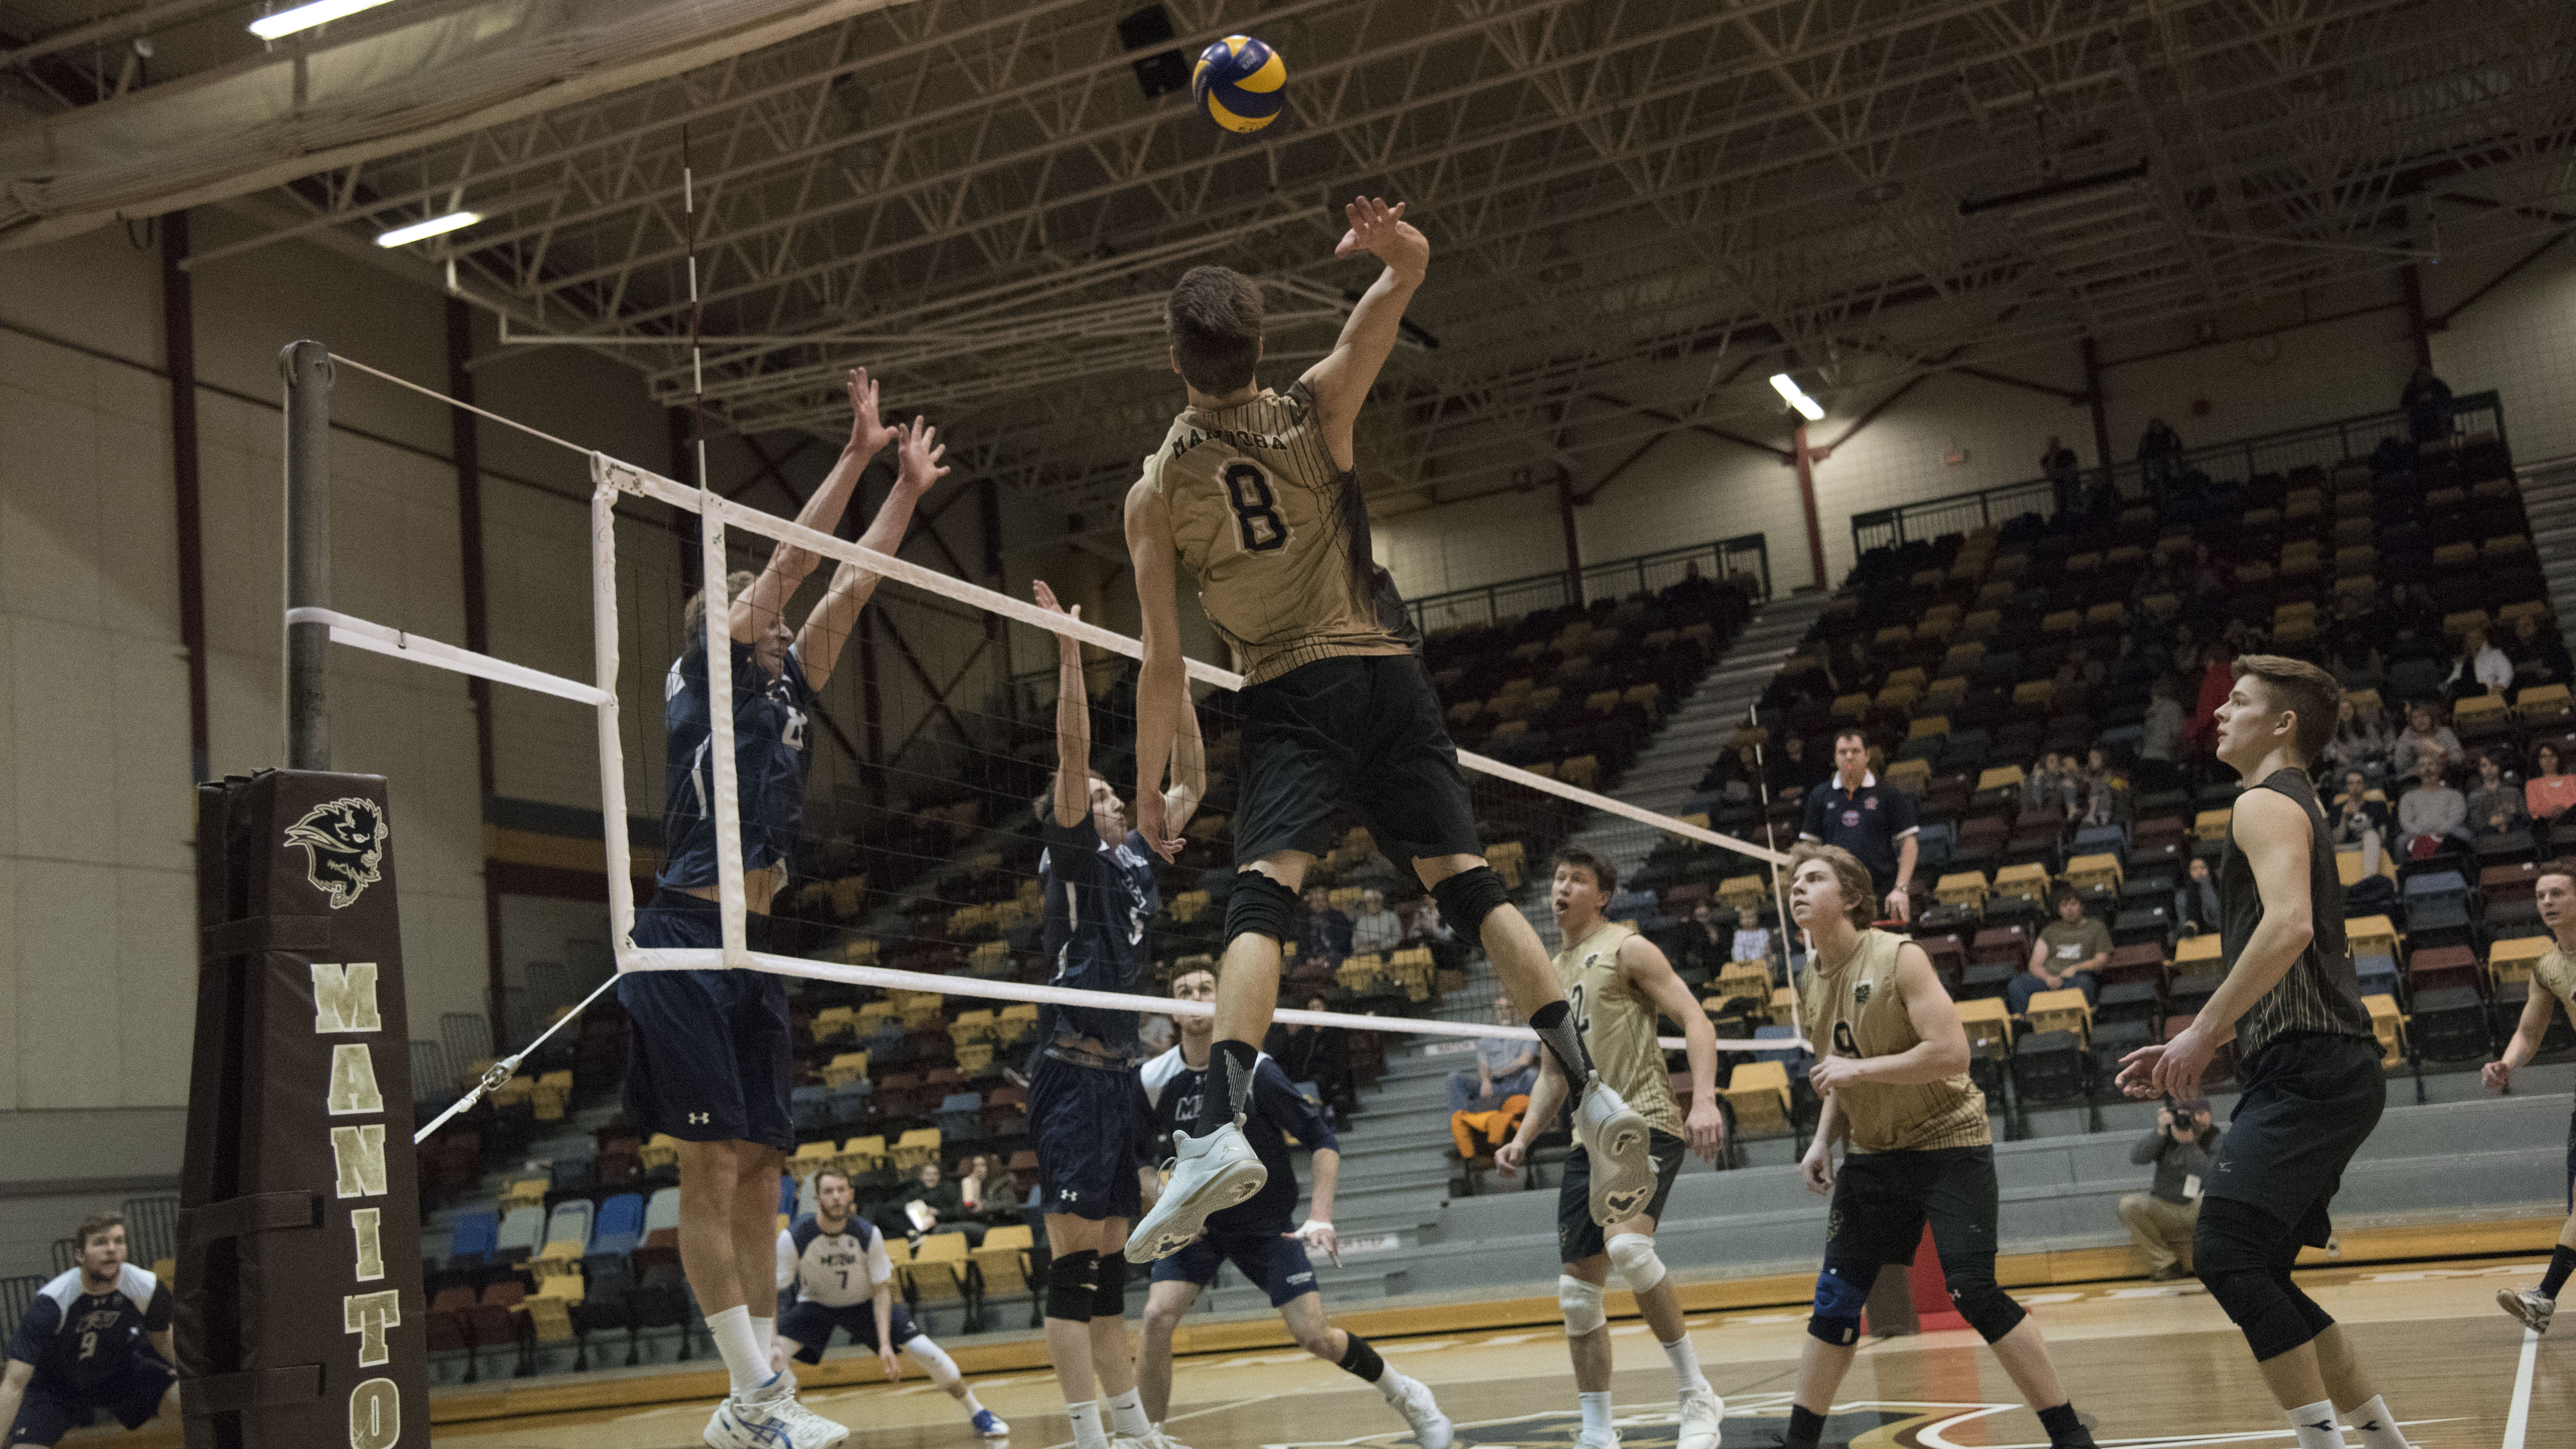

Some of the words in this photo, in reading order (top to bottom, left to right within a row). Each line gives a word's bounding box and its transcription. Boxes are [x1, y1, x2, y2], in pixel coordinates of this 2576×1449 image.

[1216, 456, 1295, 555] 8
[310, 963, 401, 1449] MANITO
[835, 1270, 850, 1289] 7
[78, 1331, 98, 1361] 9
